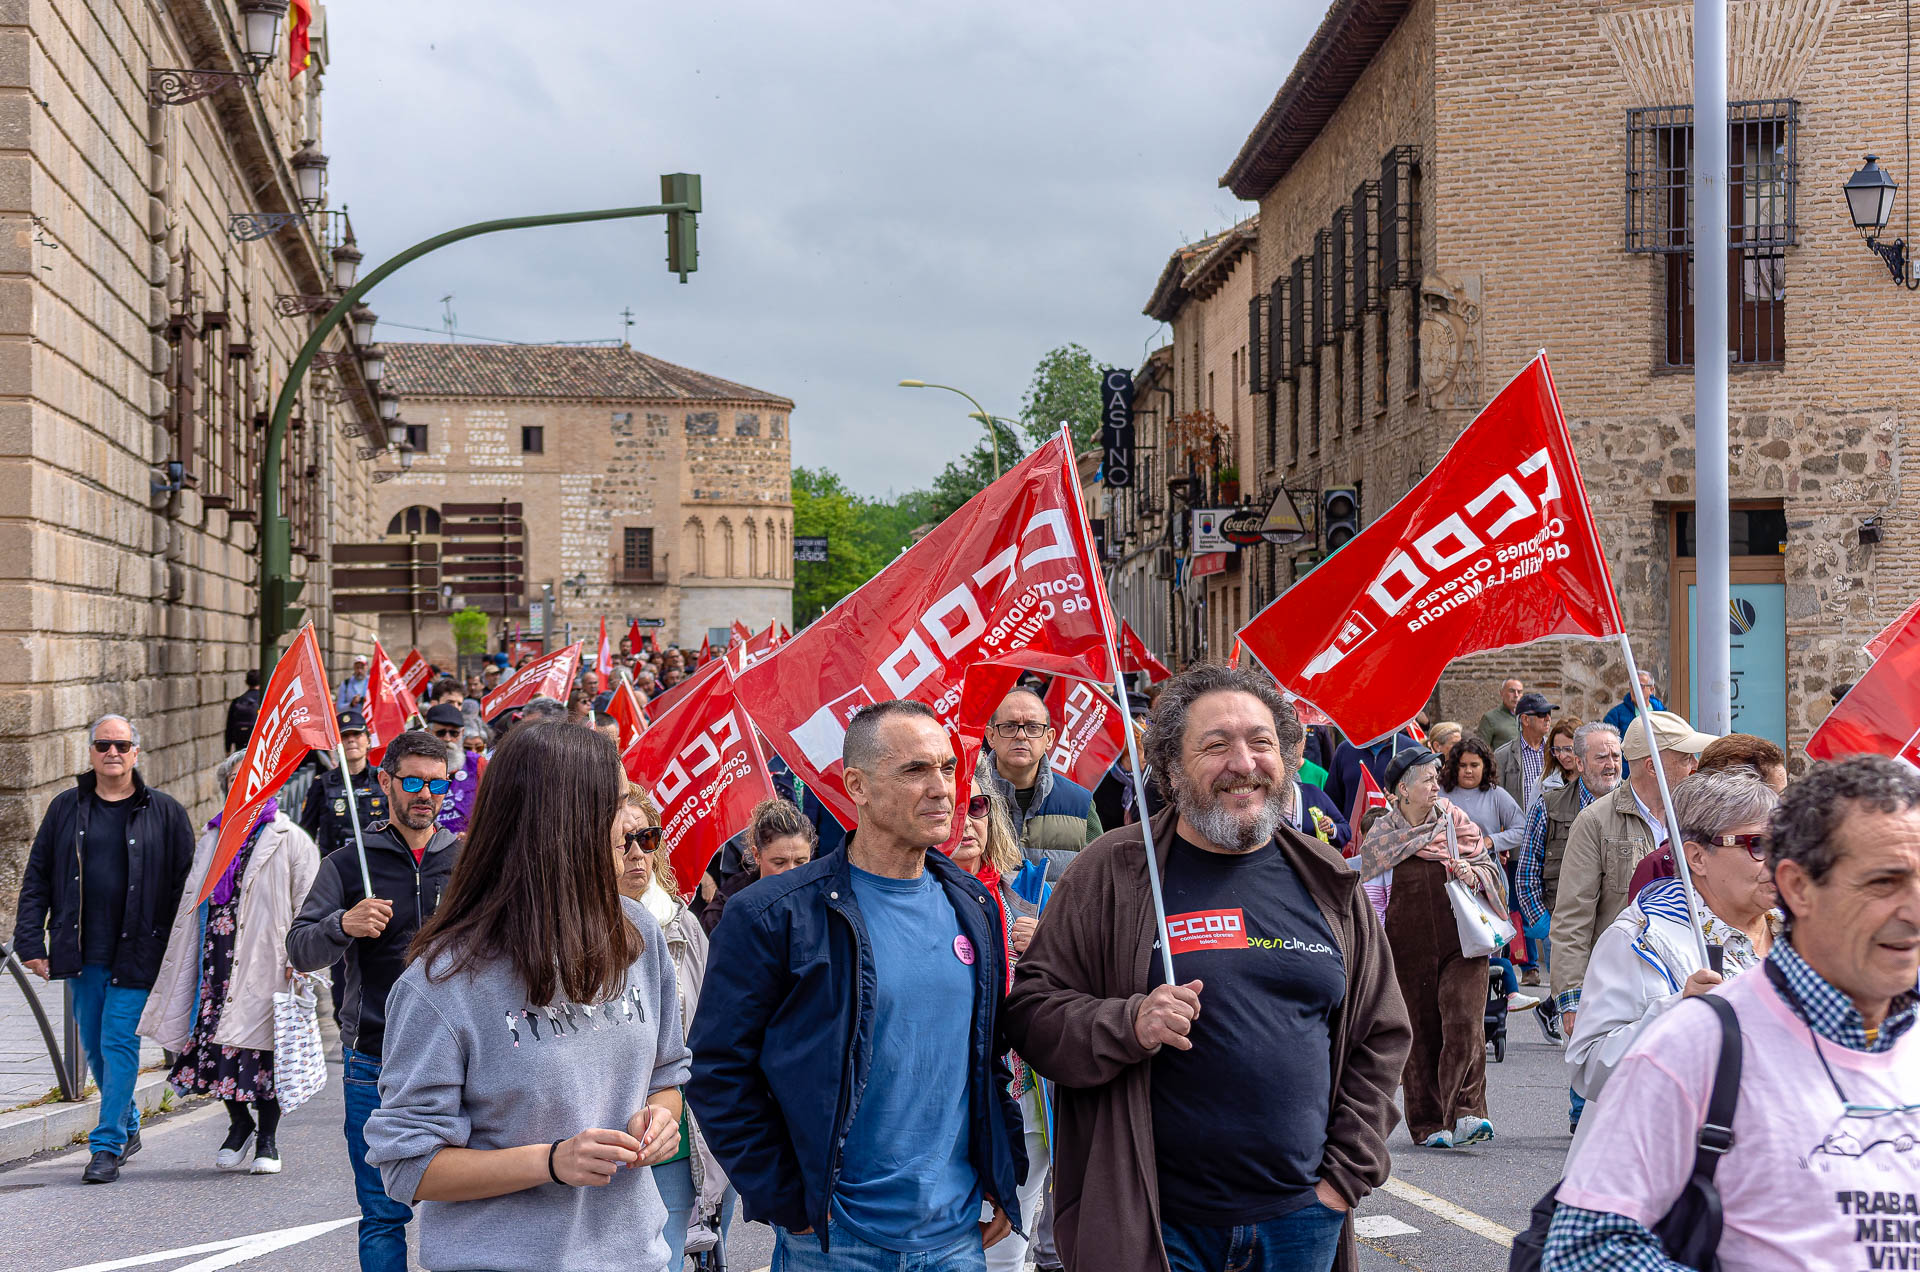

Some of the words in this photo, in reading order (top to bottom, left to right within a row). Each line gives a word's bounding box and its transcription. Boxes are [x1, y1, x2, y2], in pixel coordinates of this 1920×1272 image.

[1107, 372, 1129, 486] CASINO
[1168, 915, 1241, 937] CCOO
[1180, 933, 1212, 942] comisiones
[1835, 1191, 1919, 1215] TRABA
